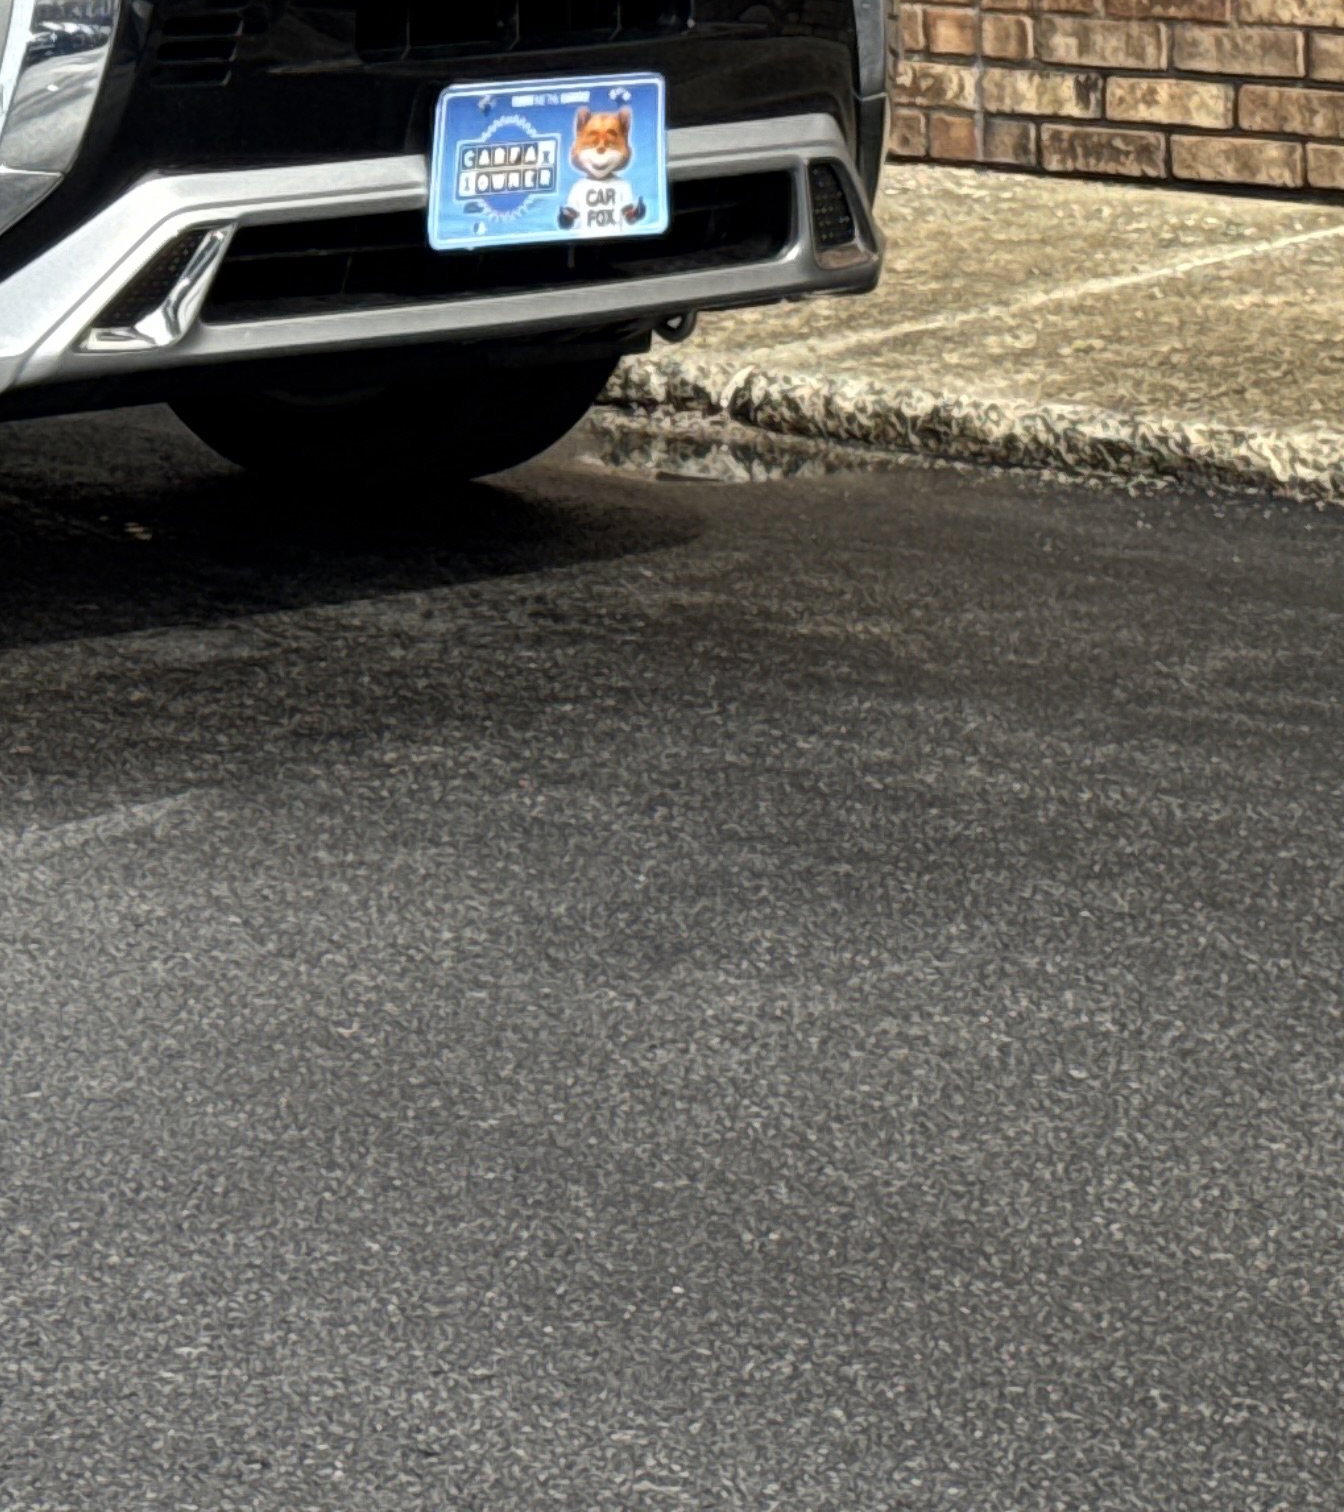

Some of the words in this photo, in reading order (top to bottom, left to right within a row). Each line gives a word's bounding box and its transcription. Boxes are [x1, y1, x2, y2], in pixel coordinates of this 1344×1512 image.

[462, 144, 553, 169] CARFAX
[475, 169, 553, 193] OWNER
[585, 188, 617, 206] CAR
[586, 209, 618, 228] FOX
